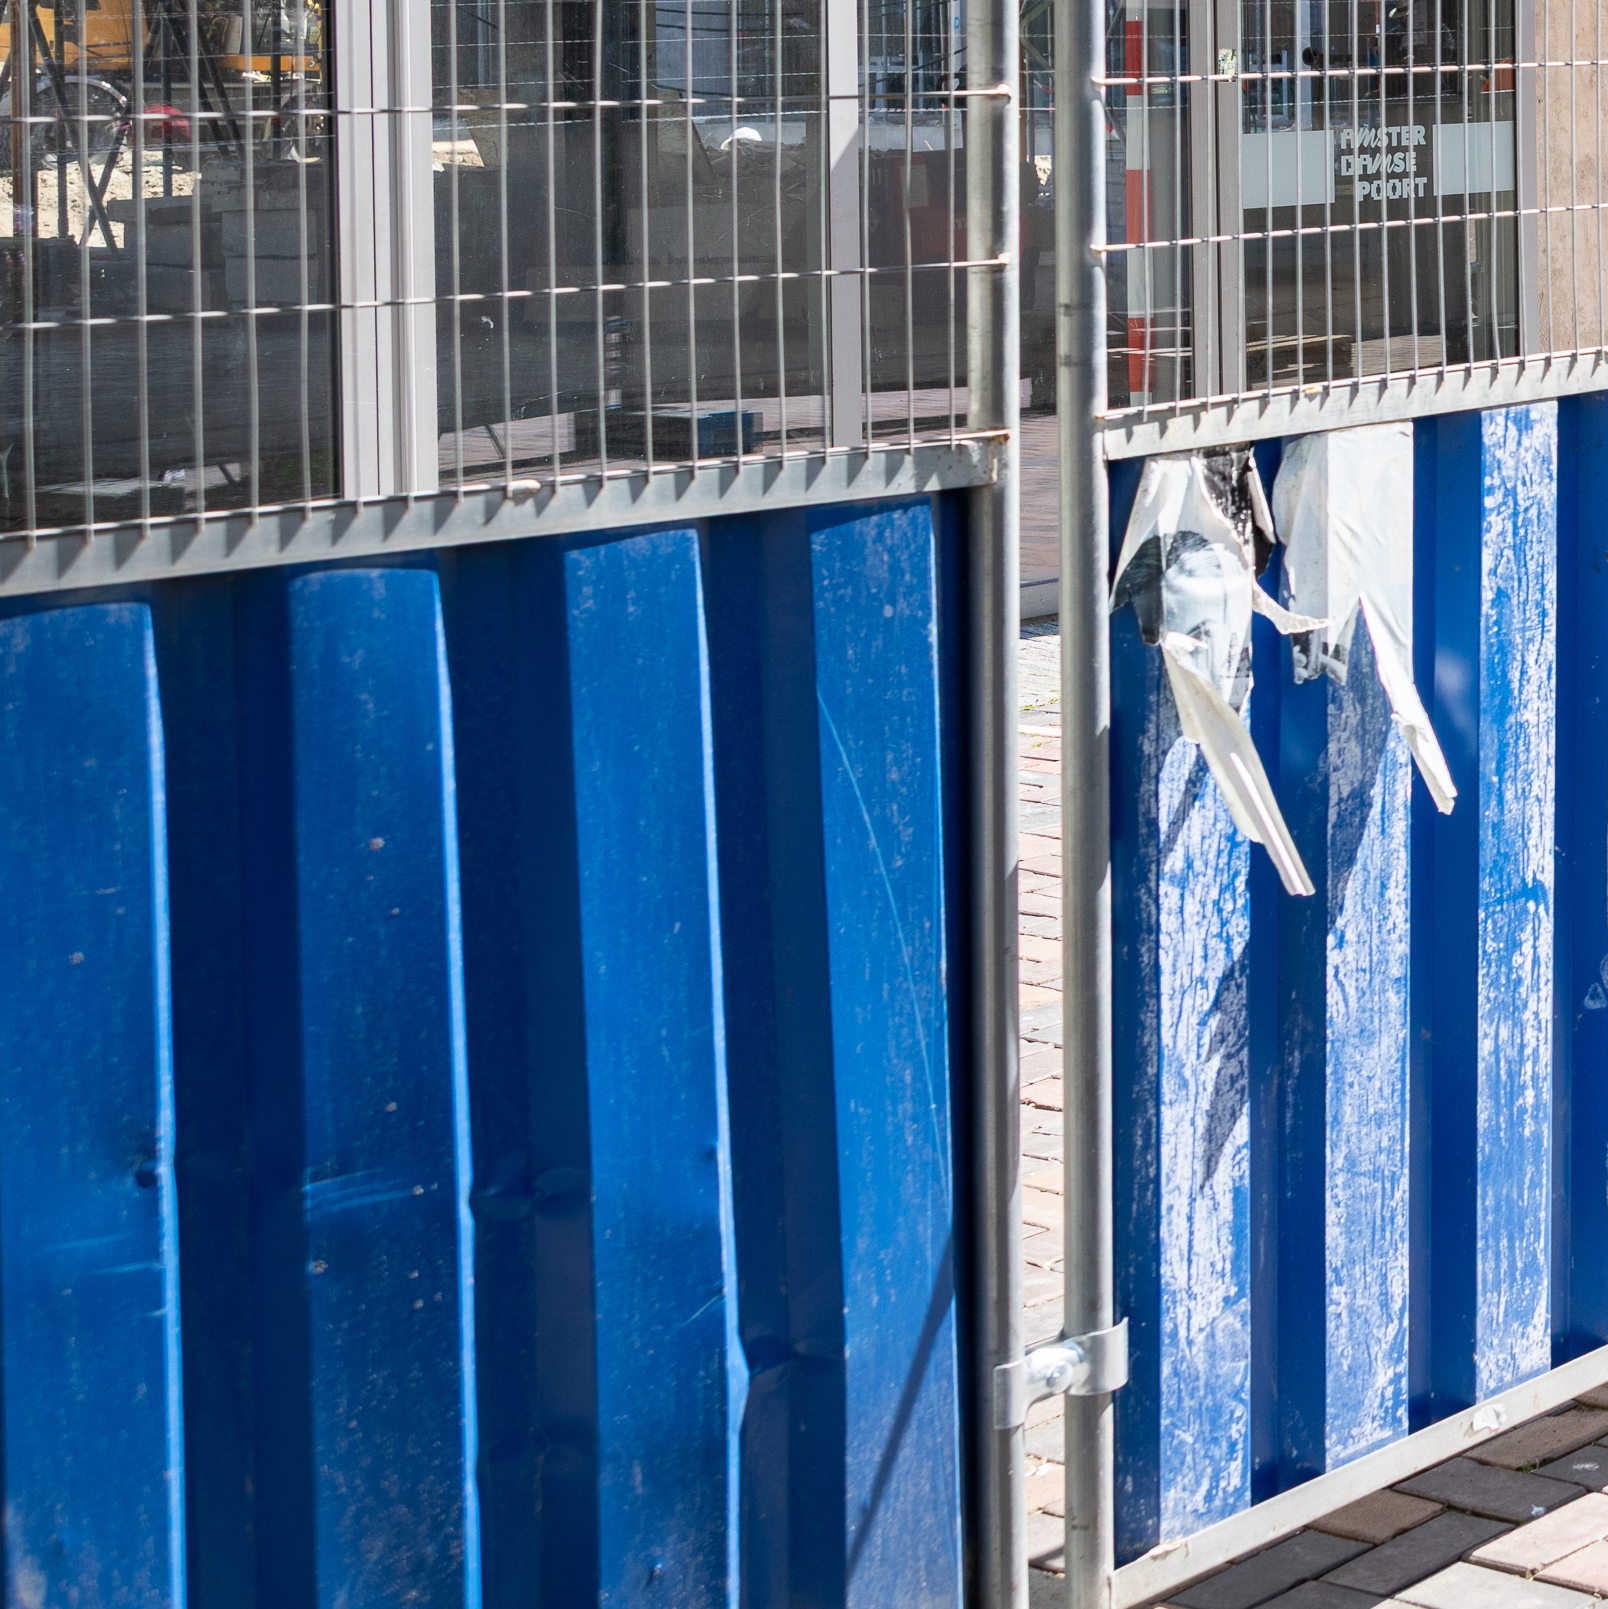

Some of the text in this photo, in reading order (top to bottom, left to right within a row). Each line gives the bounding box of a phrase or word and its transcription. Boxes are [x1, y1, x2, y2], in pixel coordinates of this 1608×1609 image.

[1341, 125, 1427, 150] AMSTER
[1341, 152, 1417, 176] DAMSE
[1358, 177, 1428, 202] POORT
